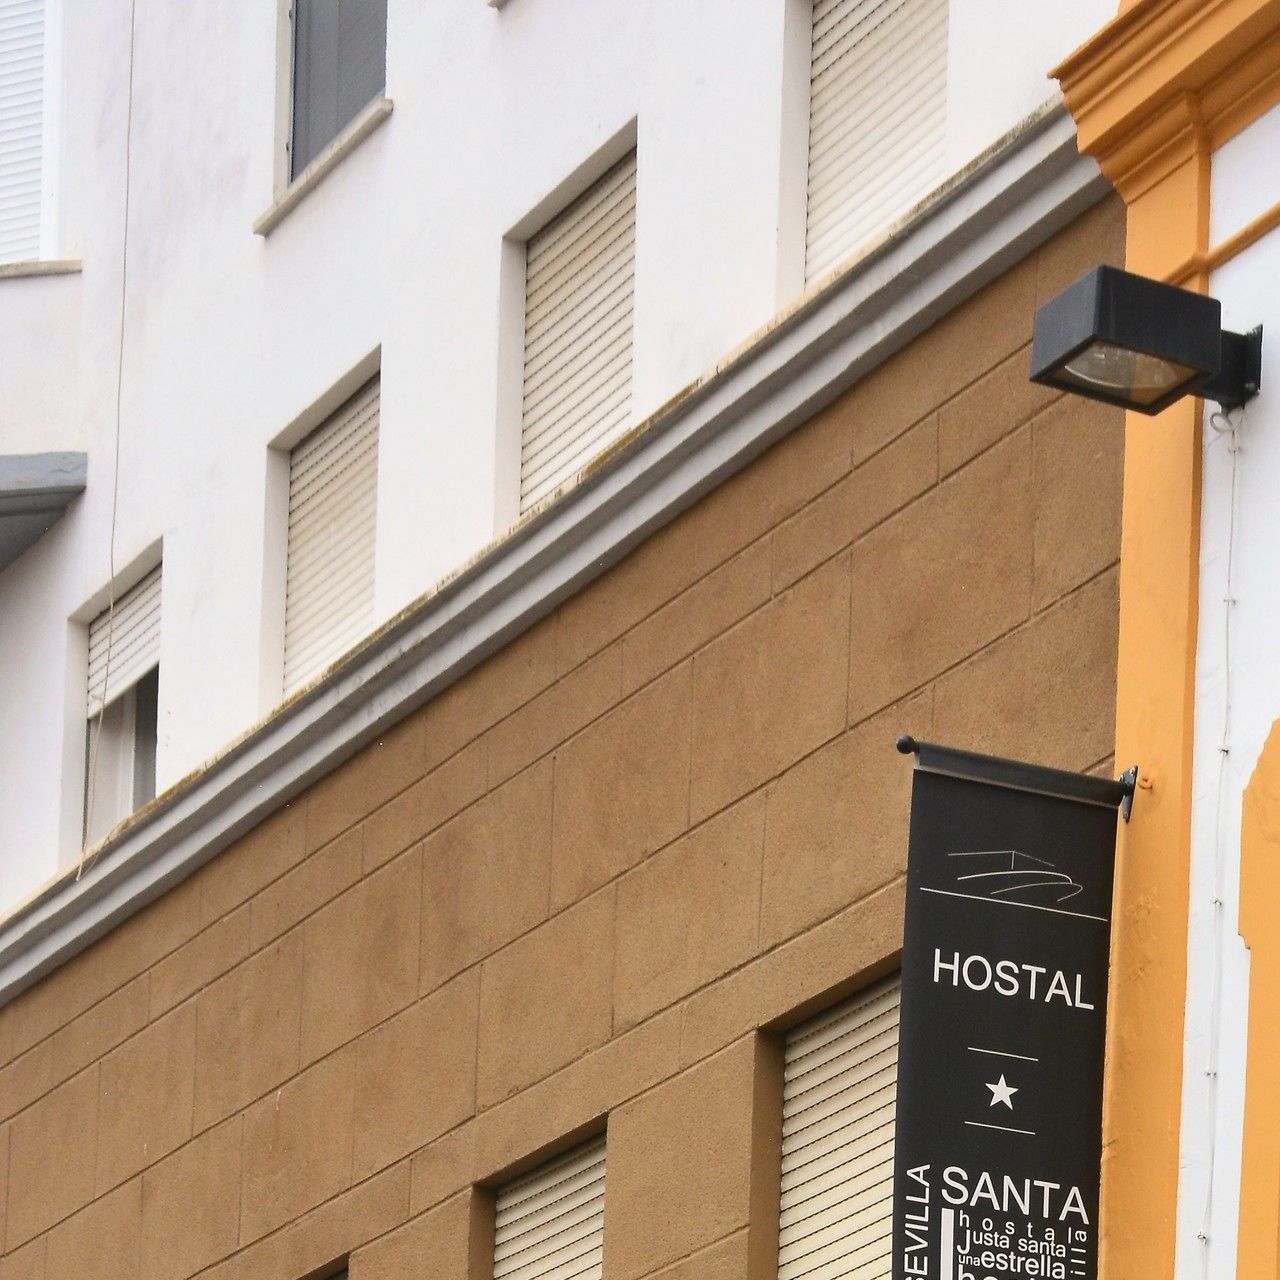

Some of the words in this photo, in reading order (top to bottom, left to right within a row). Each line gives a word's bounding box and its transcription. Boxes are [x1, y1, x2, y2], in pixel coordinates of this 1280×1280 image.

[933, 948, 1094, 1010] HOSTAL
[941, 1166, 1090, 1225] SANTA
[1018, 1237, 1066, 1258] santa
